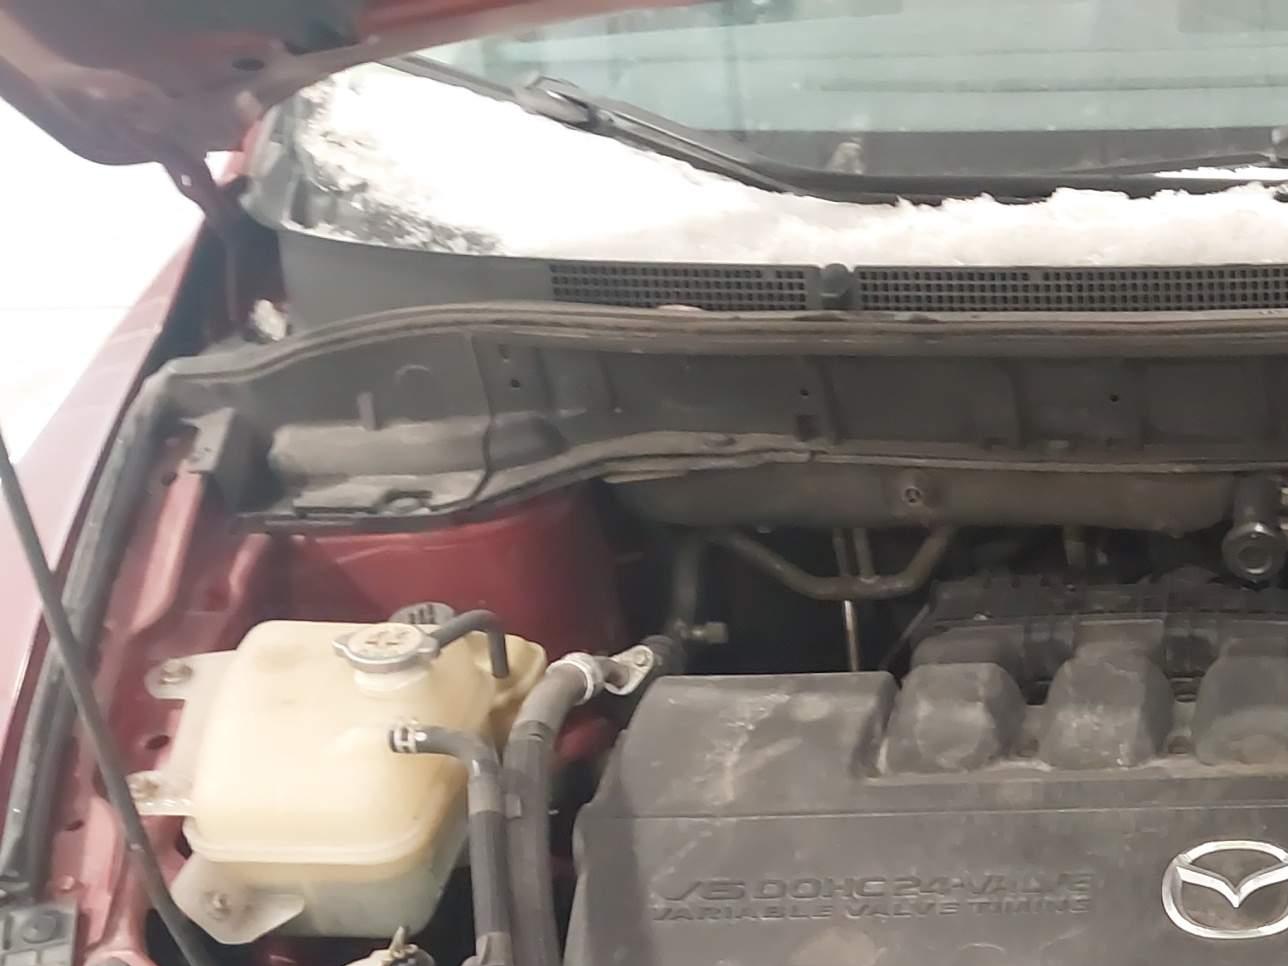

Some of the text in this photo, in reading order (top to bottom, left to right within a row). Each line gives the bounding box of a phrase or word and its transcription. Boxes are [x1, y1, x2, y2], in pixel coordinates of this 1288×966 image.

[653, 878, 746, 901] V6
[752, 877, 888, 899] DOHC
[652, 898, 1090, 921] VARIABLE VALVE TIMING
